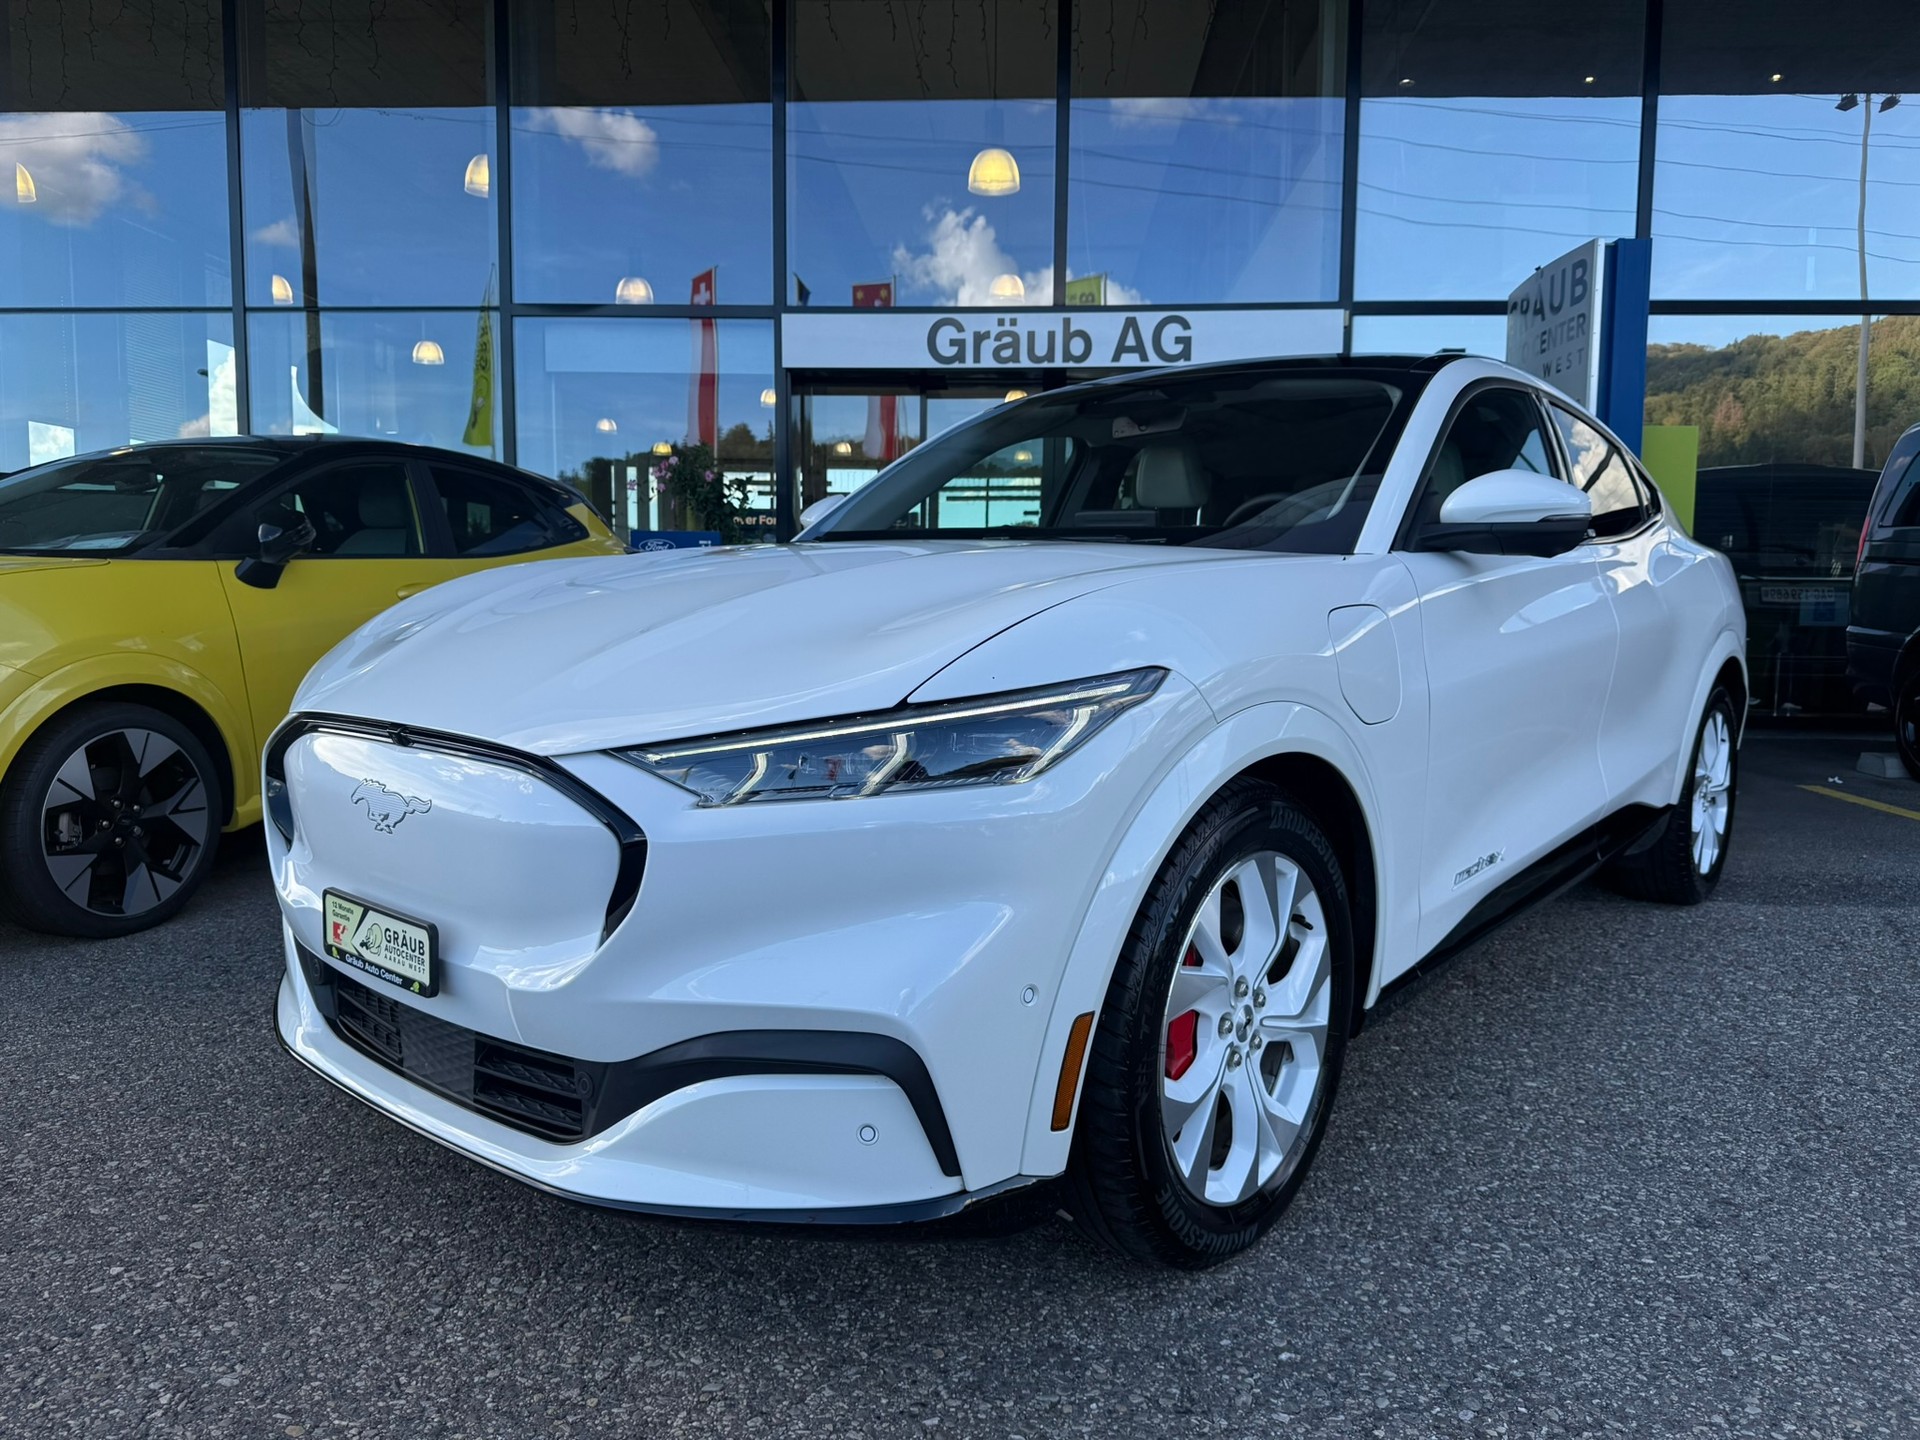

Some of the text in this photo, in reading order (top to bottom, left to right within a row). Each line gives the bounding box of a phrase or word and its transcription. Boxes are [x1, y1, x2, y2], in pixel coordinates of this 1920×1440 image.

[927, 315, 1193, 366] Gräub AG
[1542, 347, 1585, 379] WEST
[384, 927, 425, 956] GRÄUB
[384, 944, 425, 967] AUTOCENTER
[345, 953, 403, 985] Gräub Auto Center
[384, 953, 426, 975] AARAU WEST
